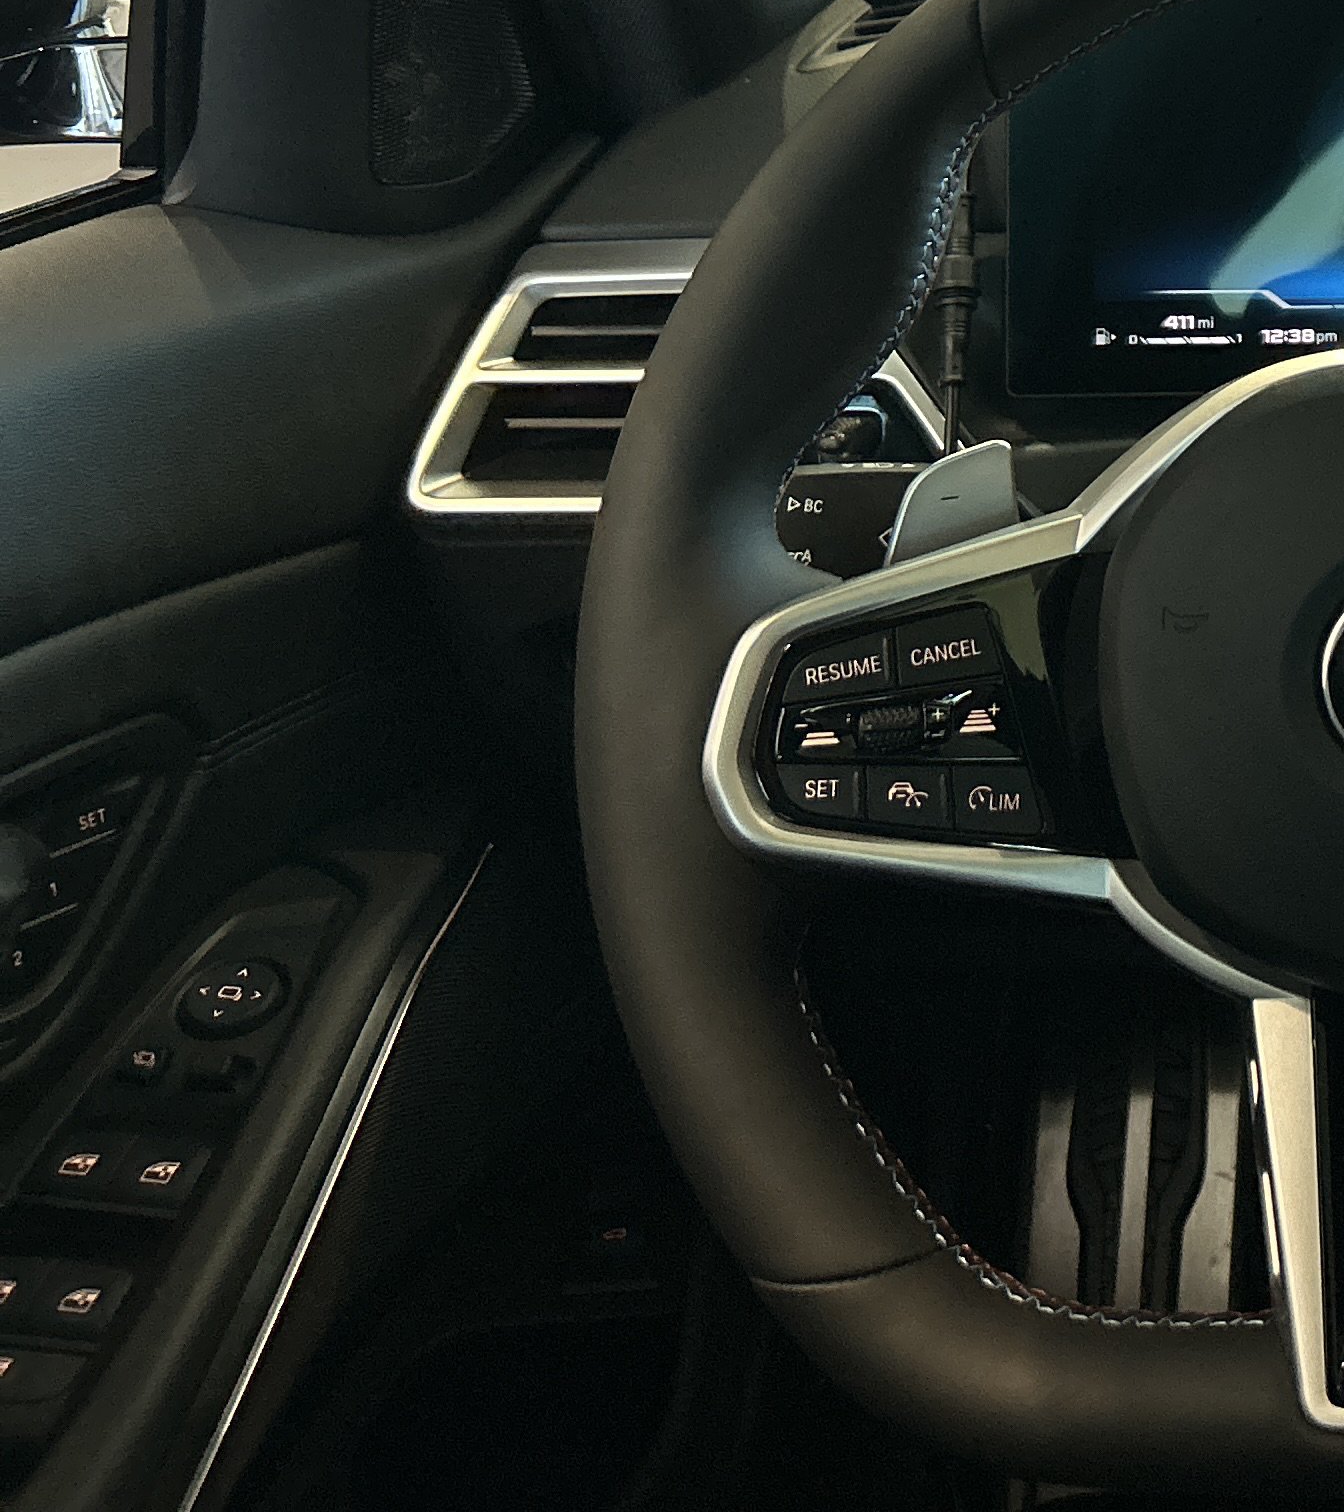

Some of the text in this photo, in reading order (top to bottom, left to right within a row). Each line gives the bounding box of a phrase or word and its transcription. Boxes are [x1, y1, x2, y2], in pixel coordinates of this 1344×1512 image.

[1162, 314, 1215, 330] 411 mi
[803, 497, 825, 514] BC
[910, 639, 983, 667] CANCEL
[804, 654, 883, 686] RESUME
[804, 779, 840, 800] SET
[989, 793, 1021, 812] LIM
[78, 807, 107, 832] SET
